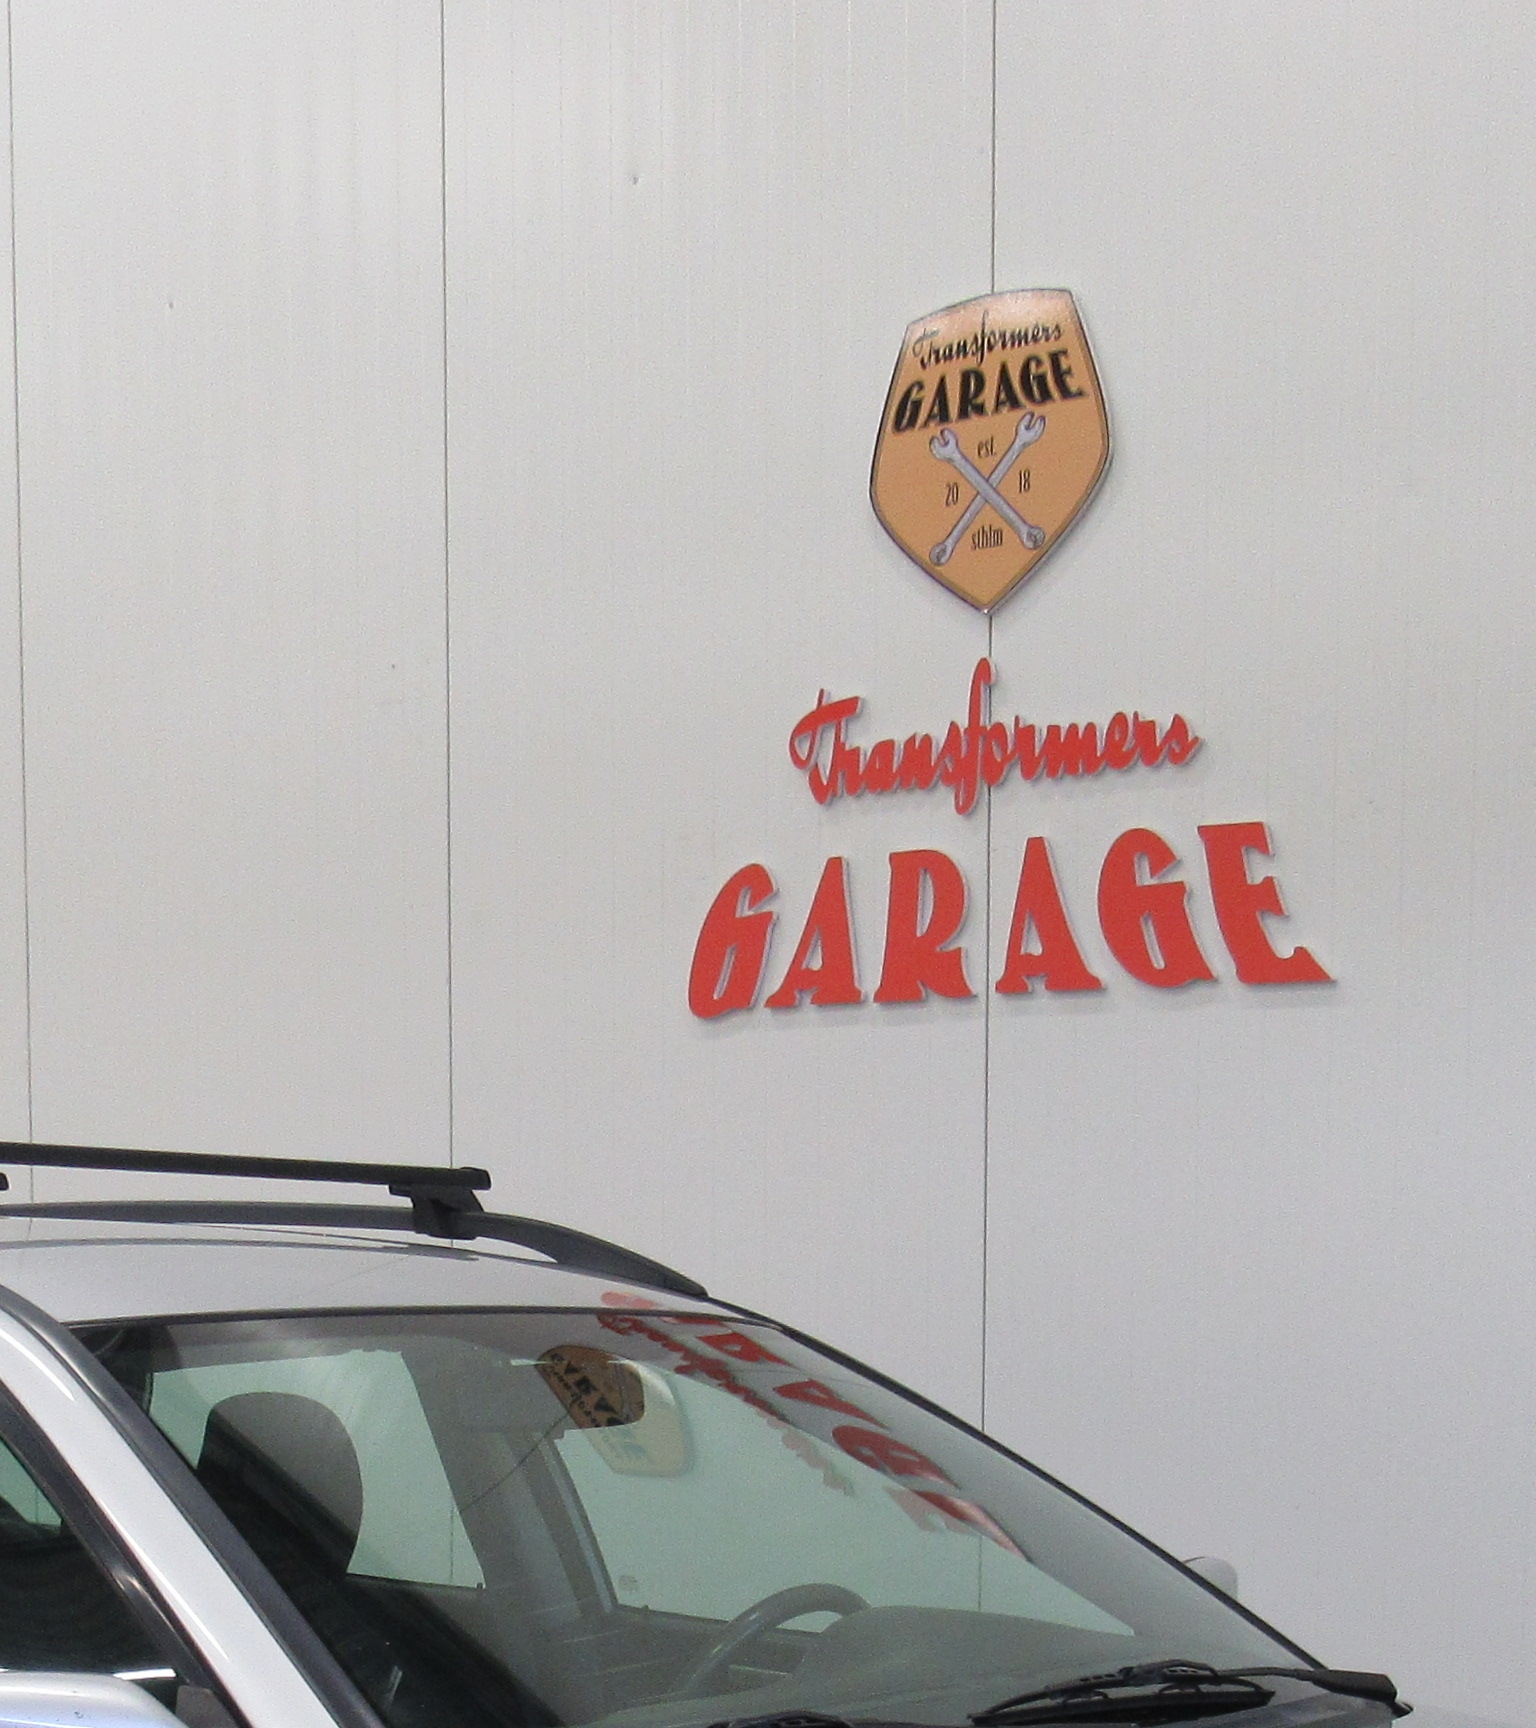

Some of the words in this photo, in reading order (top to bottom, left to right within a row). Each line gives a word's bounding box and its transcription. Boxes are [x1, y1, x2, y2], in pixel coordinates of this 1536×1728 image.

[912, 310, 1063, 370] Transformers
[892, 349, 1085, 433] GARAGE
[944, 481, 960, 508] 20
[1017, 469, 1031, 495] 18
[970, 525, 1004, 551] sthlm
[789, 658, 1200, 816] Transformers
[688, 821, 1334, 1019] GARAGE
